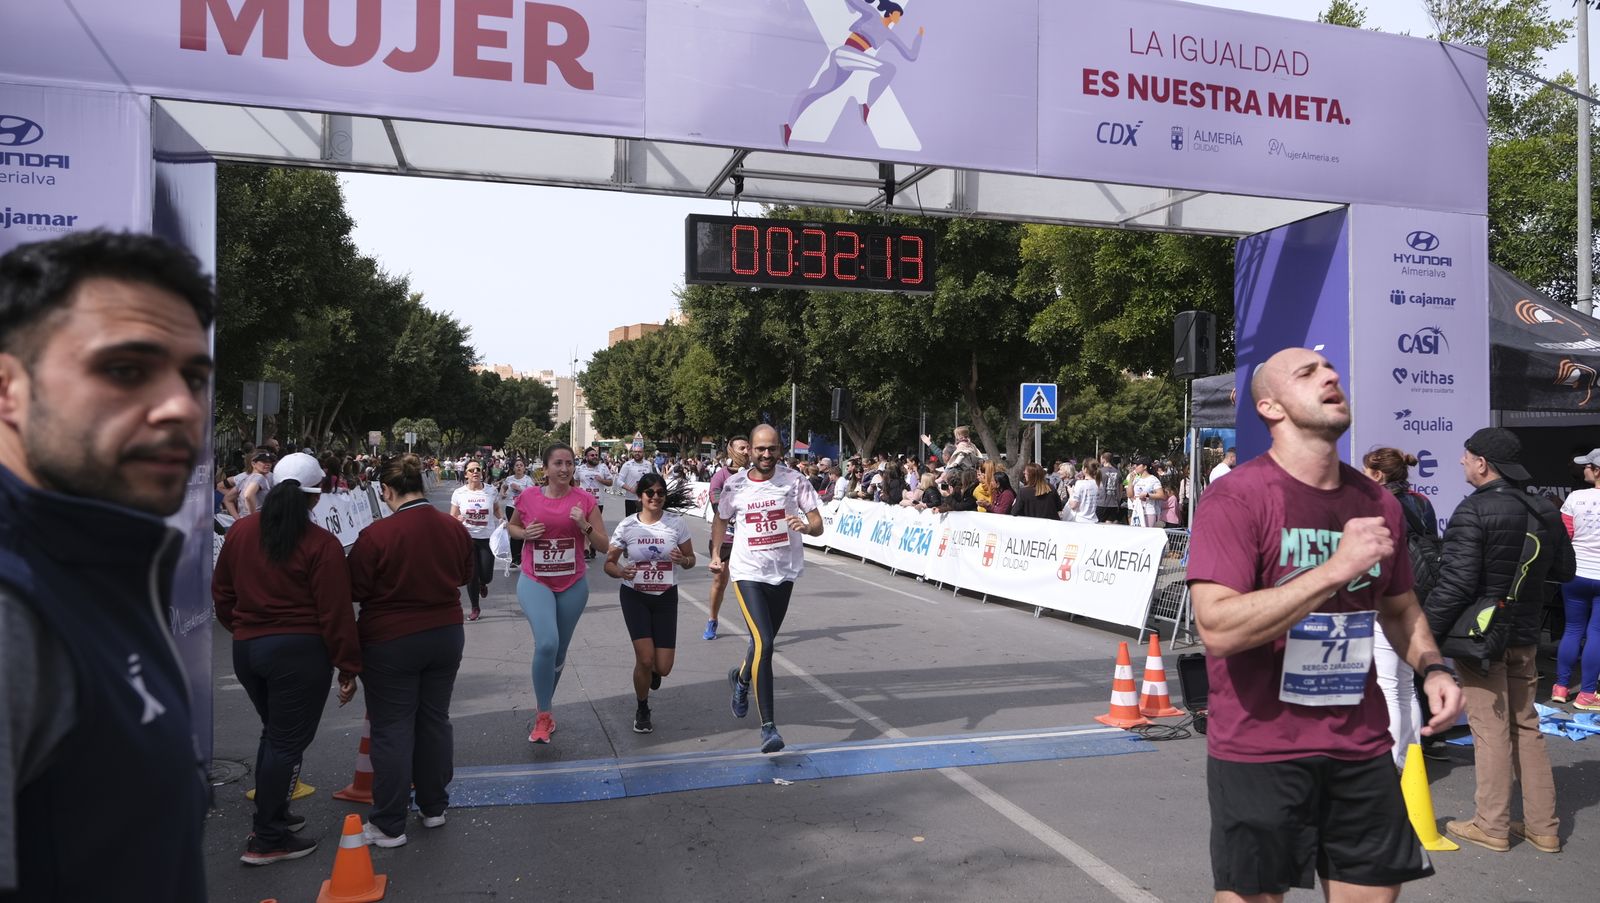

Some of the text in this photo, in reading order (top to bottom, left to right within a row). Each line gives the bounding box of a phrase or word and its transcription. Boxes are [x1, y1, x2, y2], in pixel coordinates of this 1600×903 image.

[180, 0, 594, 90] MUJER
[1130, 28, 1309, 76] LA IGUALDAD
[1082, 68, 1351, 125] ES NUESTRA META.
[1096, 120, 1143, 147] CDX
[1193, 129, 1243, 146] ALMERÍA
[1193, 142, 1220, 153] CIUDAD
[0, 151, 70, 169] NDAI
[731, 224, 924, 284] 00:32:13
[1393, 253, 1452, 267] HYUNDAI
[1401, 266, 1446, 278] Almerialva
[1409, 292, 1456, 308] cajamar
[1411, 370, 1454, 385] vithas
[1403, 417, 1453, 435] aqualia
[1408, 483, 1439, 496] lece
[747, 499, 776, 510] MUJER
[755, 520, 777, 533] 816
[543, 550, 566, 560] 877
[1005, 537, 1058, 562] ALMERÍA
[1002, 556, 1029, 572] CIUDAD
[1085, 548, 1151, 574] ALMERÍA
[643, 570, 664, 581] 876
[1083, 569, 1116, 586] CIUDAD
[1321, 640, 1349, 663] 71
[1302, 662, 1365, 672] SERGIO ZARAGOZA
